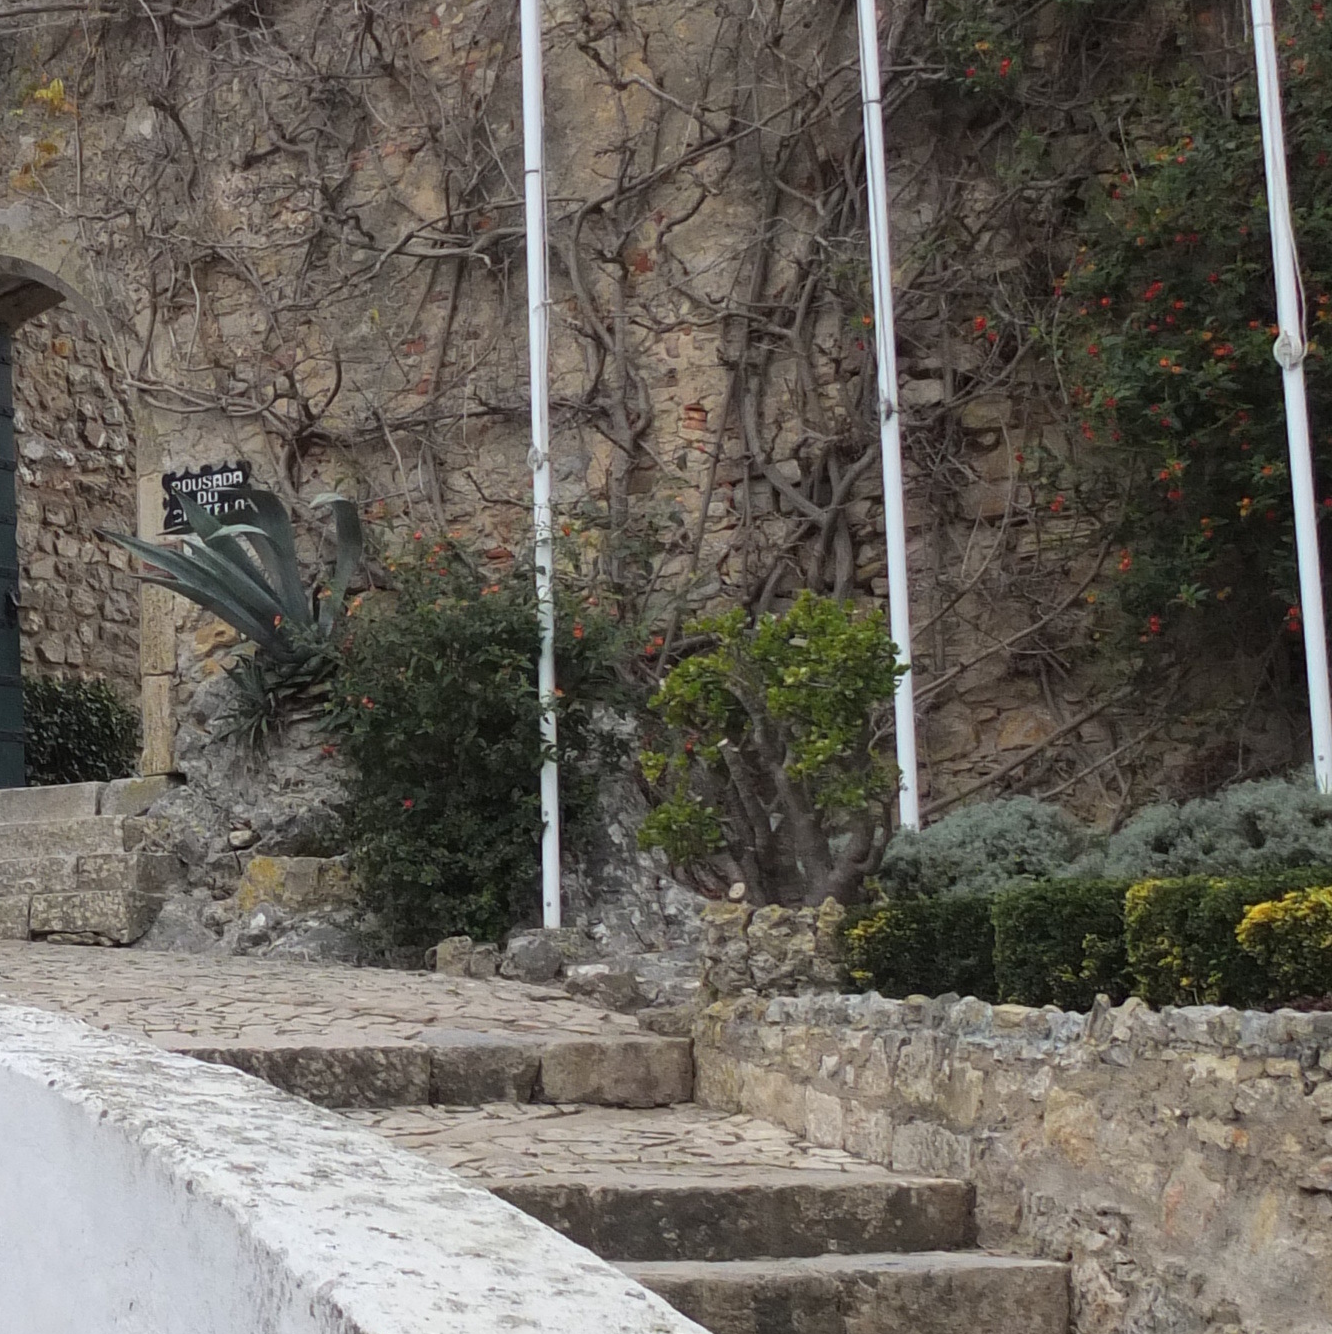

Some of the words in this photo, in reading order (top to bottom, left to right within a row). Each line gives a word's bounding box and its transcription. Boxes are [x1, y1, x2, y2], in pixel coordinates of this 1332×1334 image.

[171, 471, 243, 495] POUSADA
[197, 491, 218, 505] DO
[172, 498, 245, 523] CTELO
